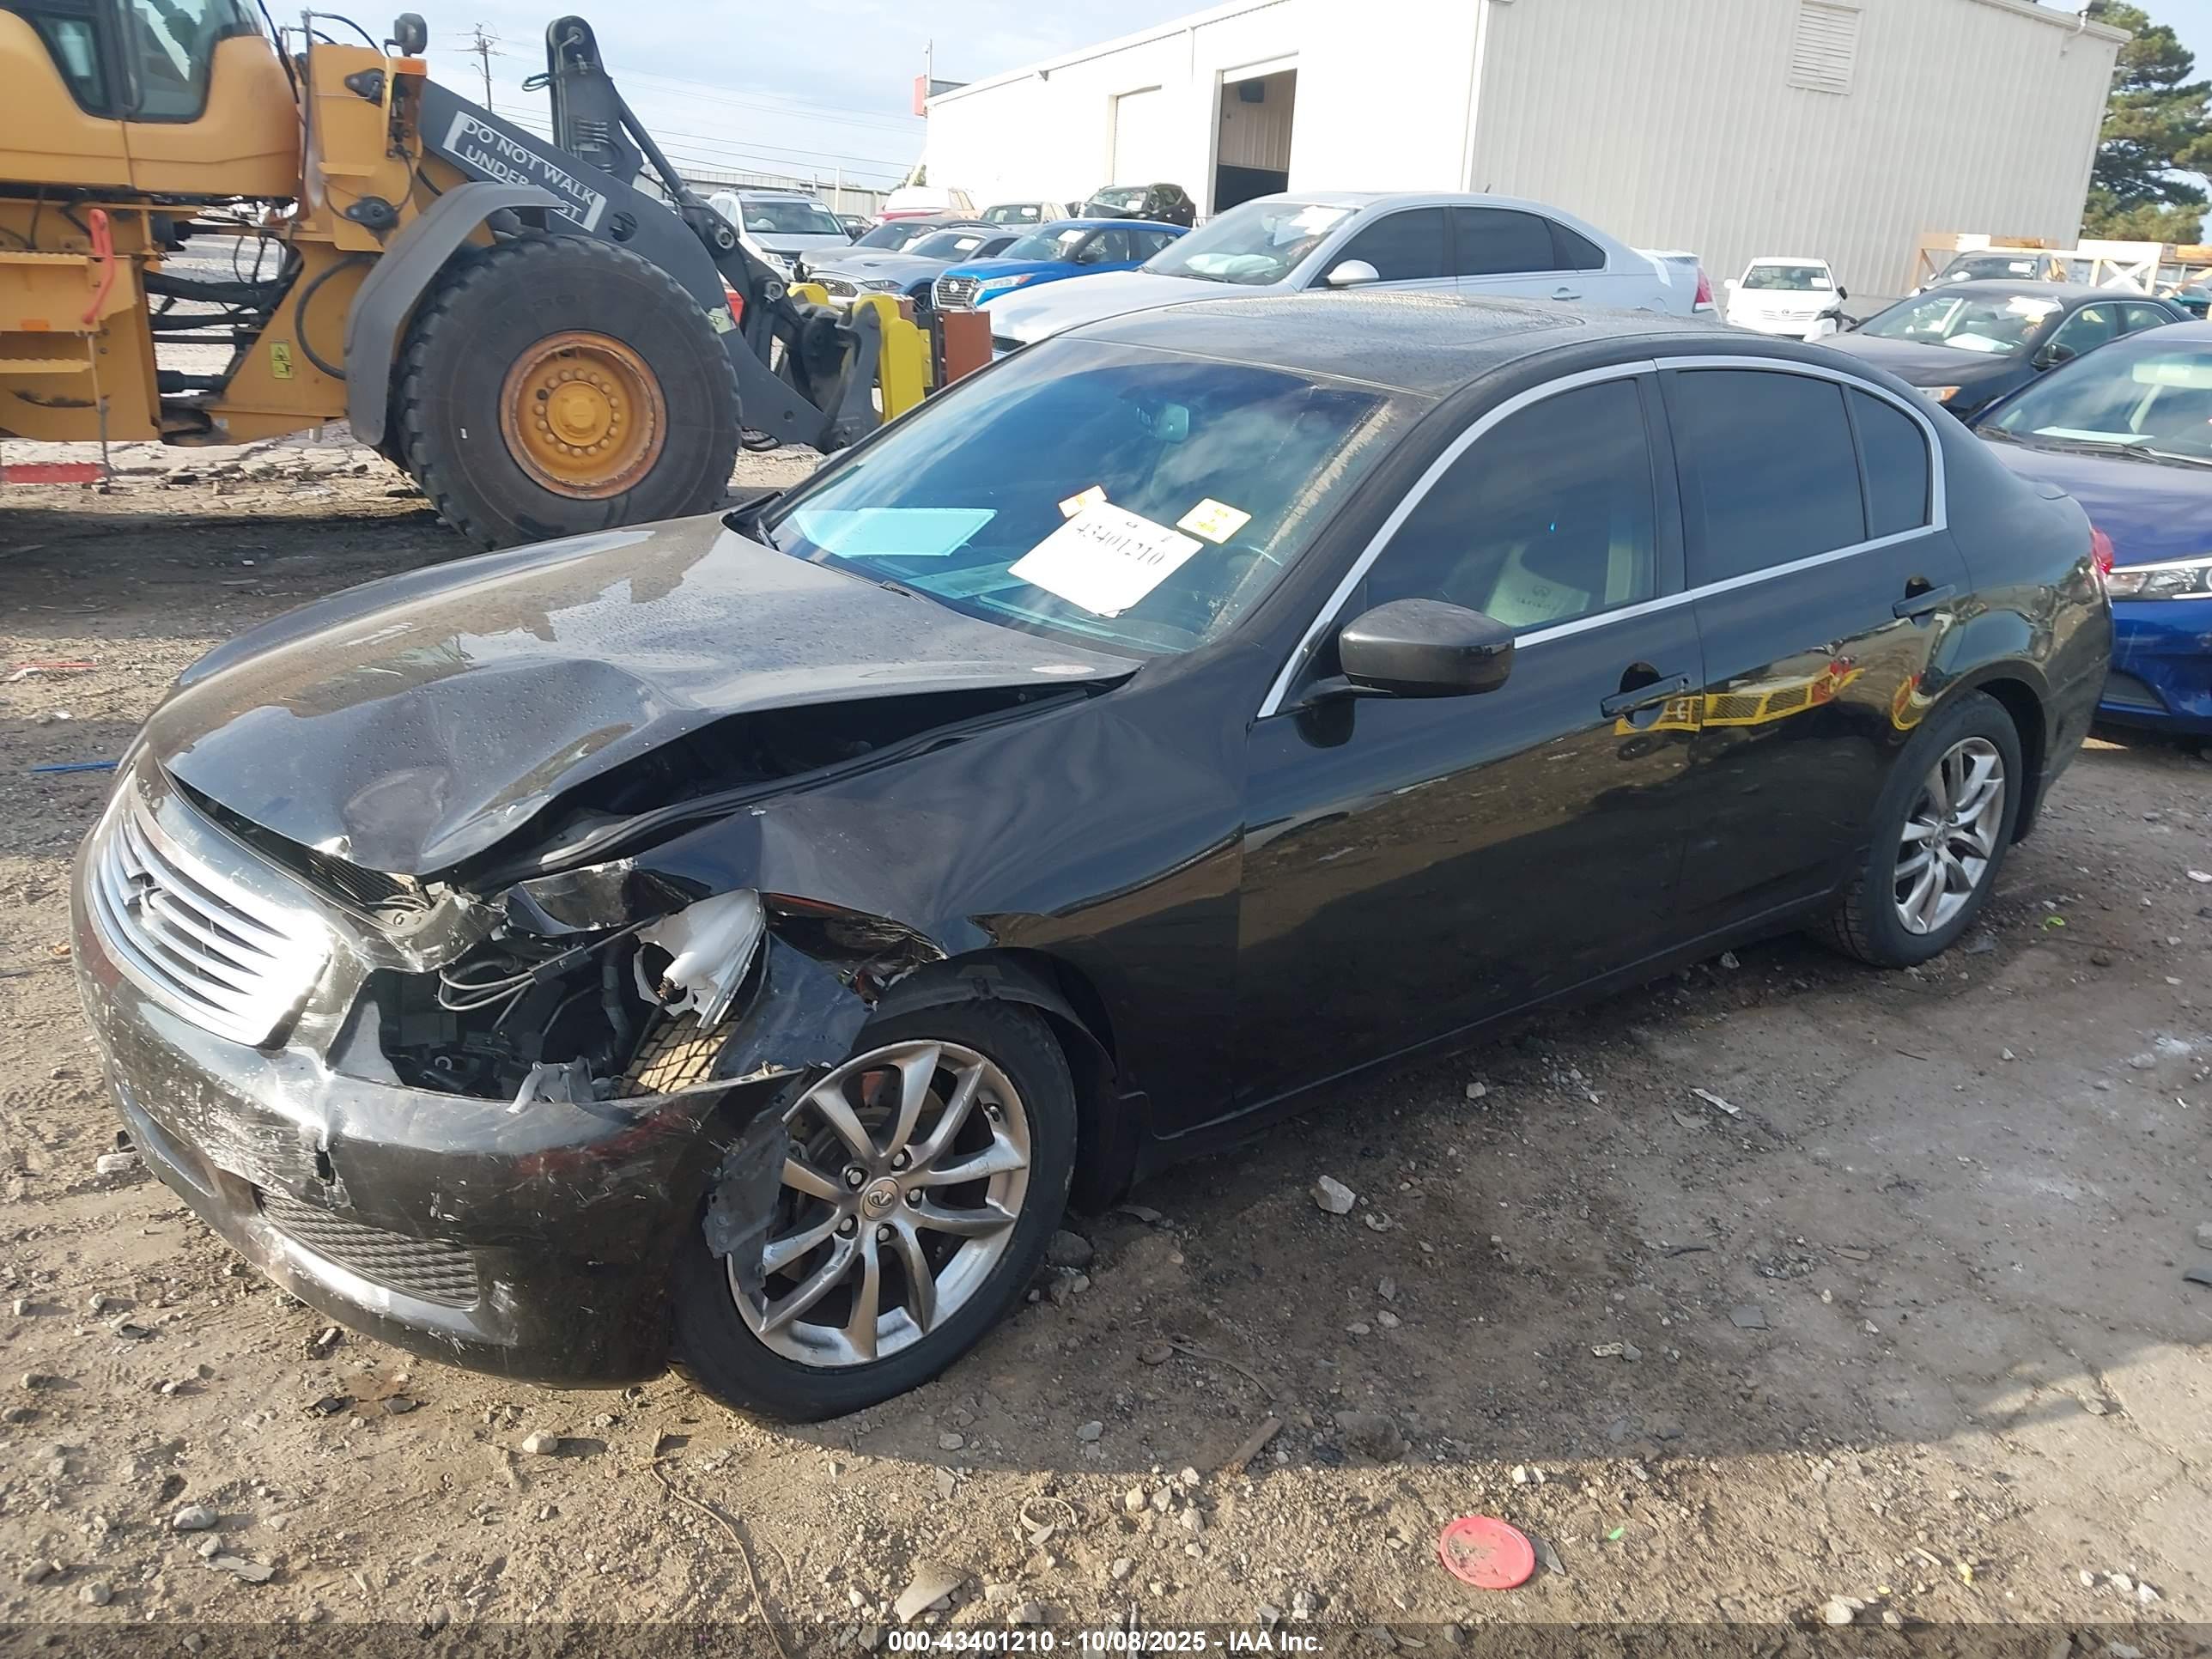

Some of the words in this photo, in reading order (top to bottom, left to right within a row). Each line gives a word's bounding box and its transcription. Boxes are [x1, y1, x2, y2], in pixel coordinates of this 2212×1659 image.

[465, 118, 494, 143] DO
[496, 138, 541, 170] NOT
[544, 164, 595, 206] WALK
[465, 143, 530, 186] UNDER
